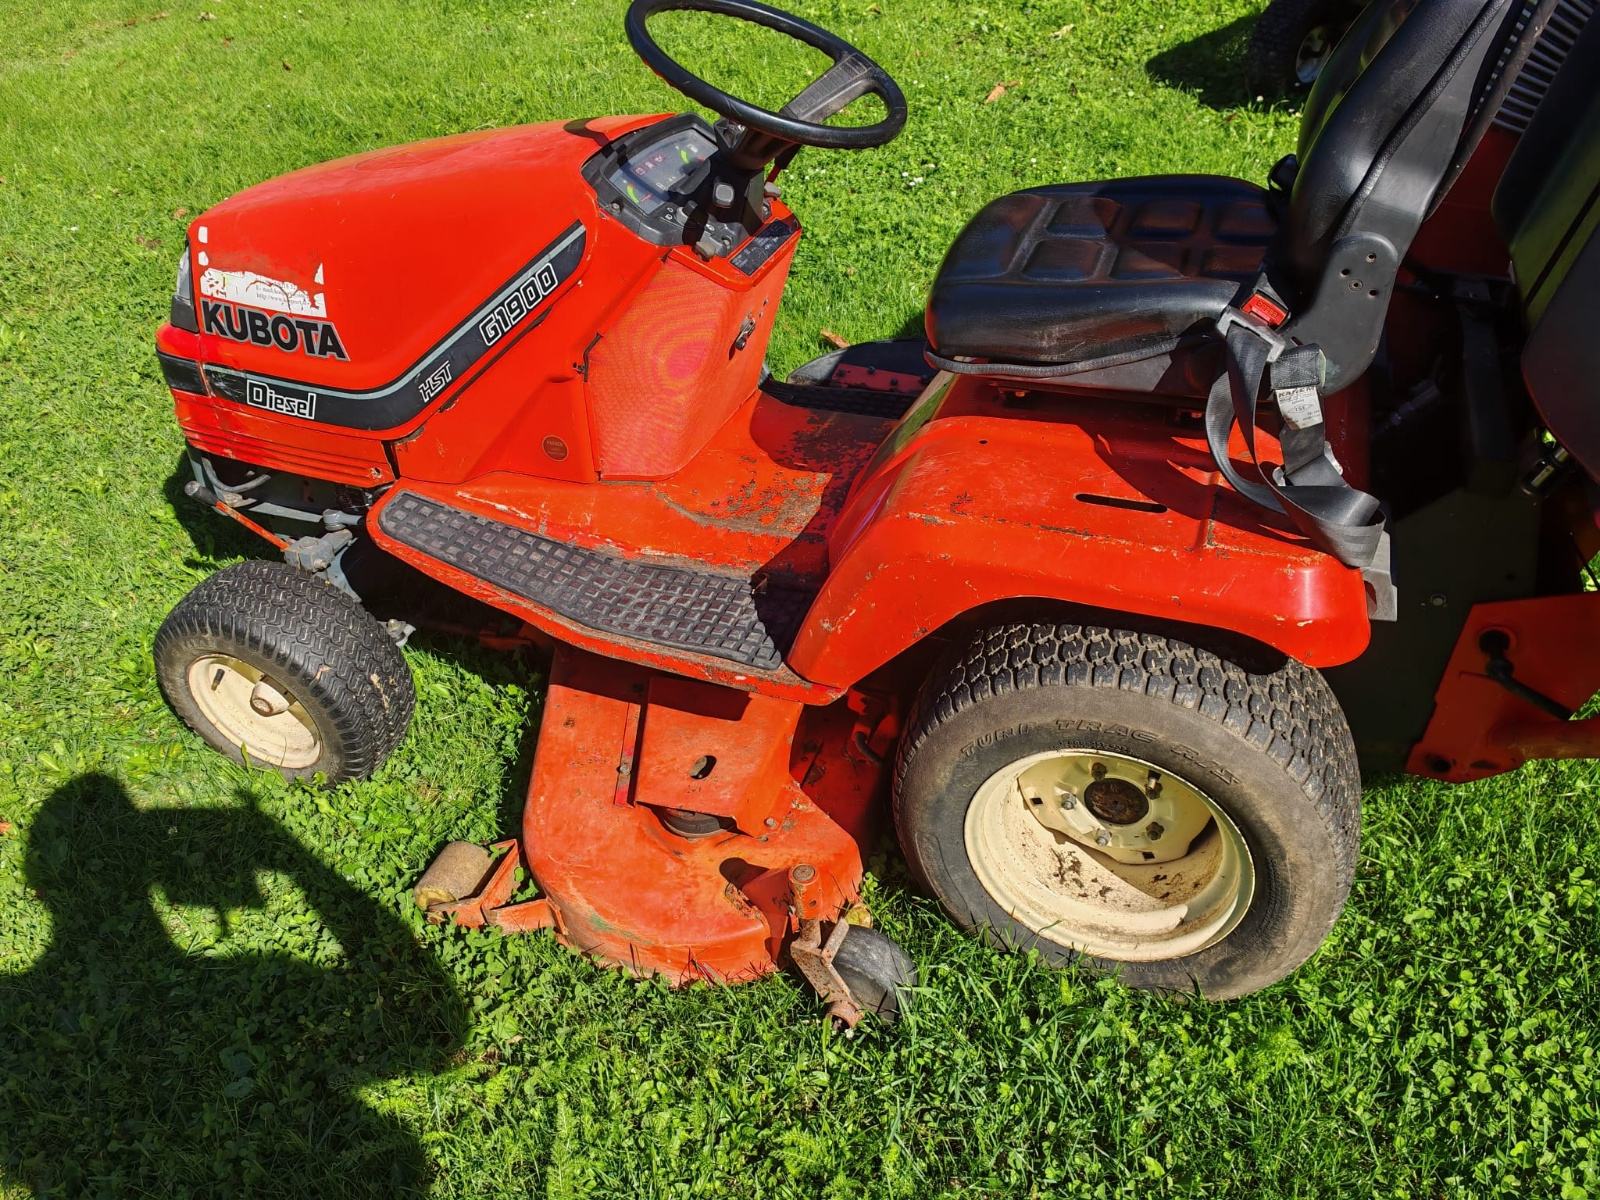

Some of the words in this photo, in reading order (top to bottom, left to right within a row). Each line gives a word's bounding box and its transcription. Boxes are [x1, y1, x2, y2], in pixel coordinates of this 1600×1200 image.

[479, 262, 558, 346] G1900
[201, 299, 349, 361] KUBOTA
[246, 379, 316, 420] Diesel
[418, 360, 452, 403] HST
[1055, 719, 1158, 743] TRAC
